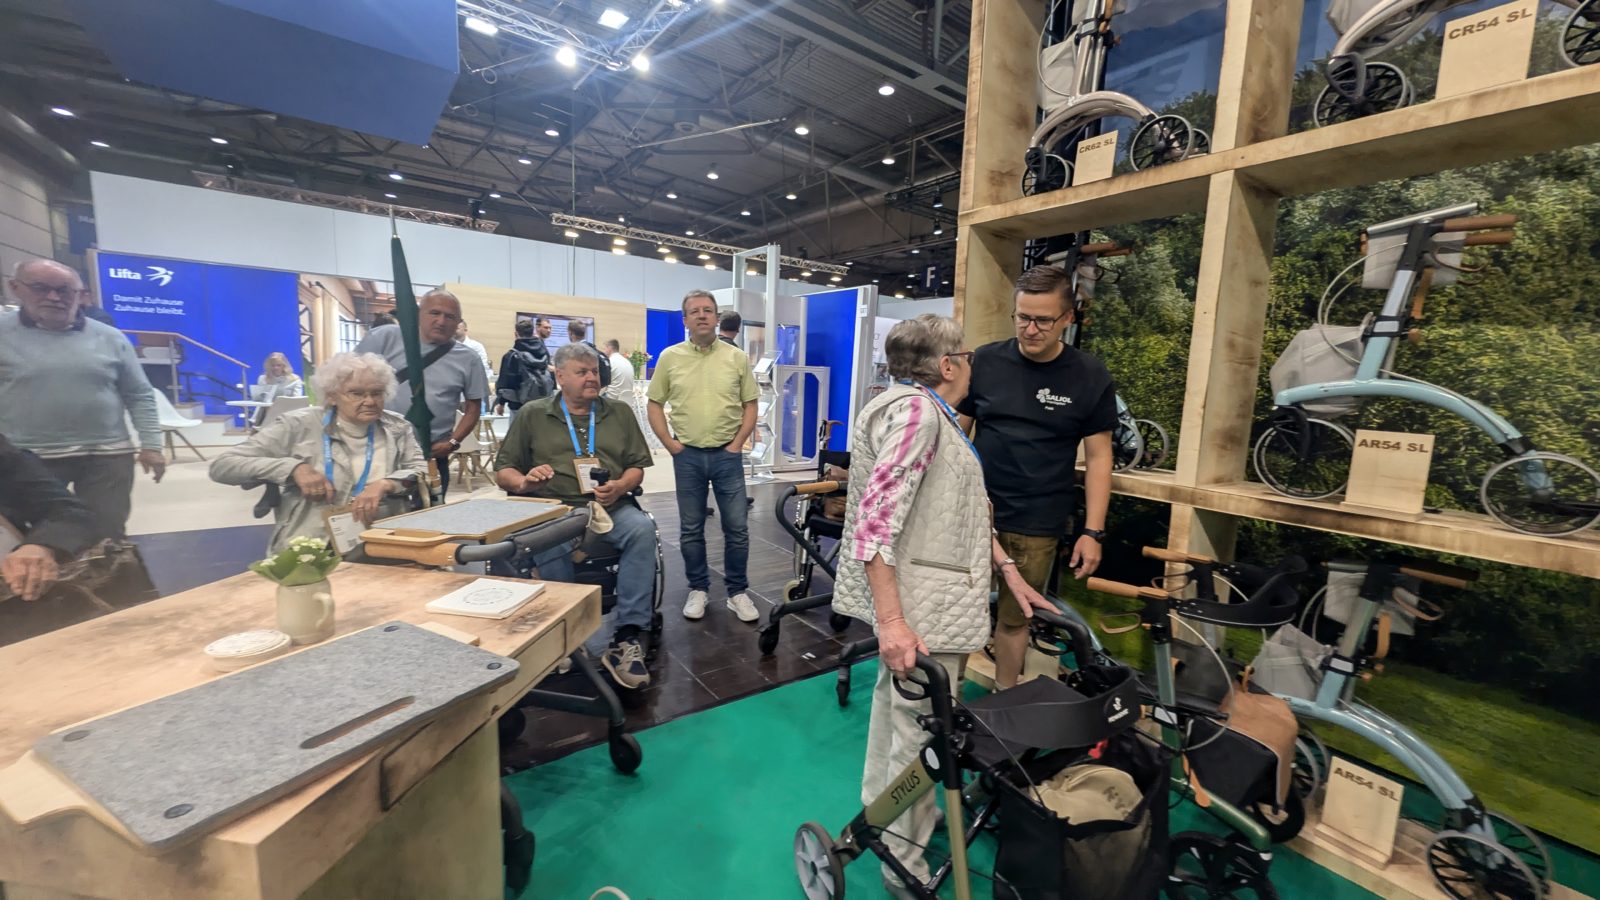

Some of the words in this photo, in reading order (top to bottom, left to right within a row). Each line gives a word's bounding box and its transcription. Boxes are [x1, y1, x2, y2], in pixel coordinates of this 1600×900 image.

[1448, 16, 1500, 40] CR54
[1506, 8, 1533, 23] SL
[1079, 141, 1102, 154] CR62
[1103, 137, 1115, 147] SL
[108, 267, 142, 280] Lifta
[926, 266, 936, 288] F
[112, 294, 143, 304] Damit
[143, 296, 185, 306] Zuhause
[113, 303, 155, 314] Zuhause
[156, 306, 186, 316] bleibt.
[1358, 438, 1402, 451] AR54
[1406, 442, 1429, 453] SL
[890, 769, 921, 805] STYLUS
[1333, 767, 1374, 790] AR54
[1378, 785, 1399, 802] SL
